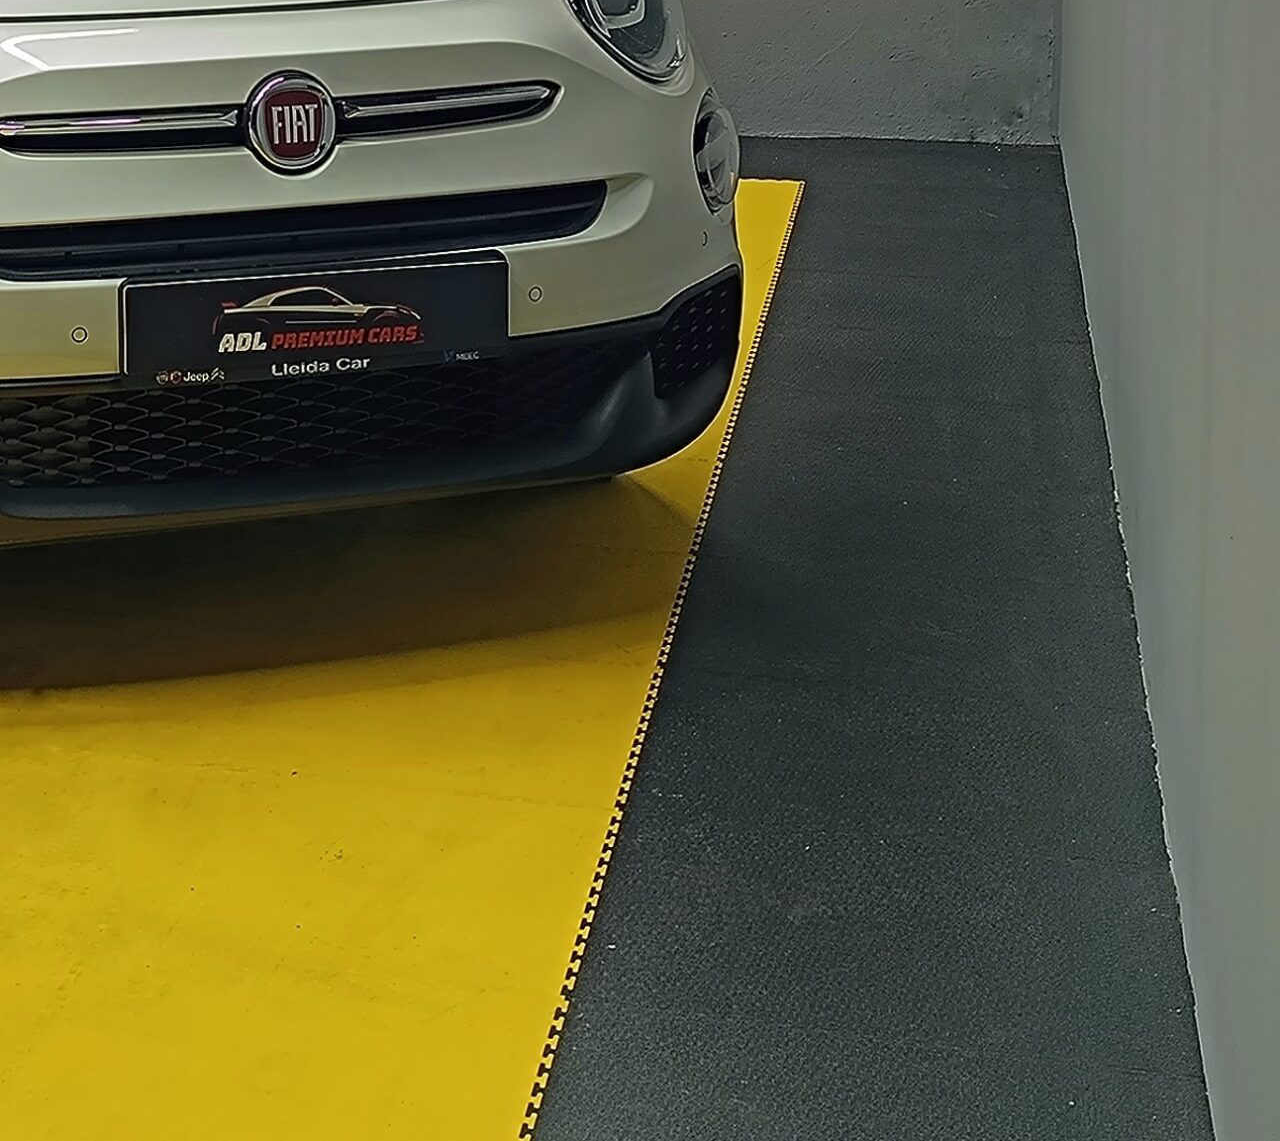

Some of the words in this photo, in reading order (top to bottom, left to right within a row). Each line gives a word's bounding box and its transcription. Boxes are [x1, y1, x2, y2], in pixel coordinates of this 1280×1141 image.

[271, 103, 318, 145] FIAT
[218, 331, 268, 353] ADL
[271, 328, 365, 350] PREMIUM
[367, 325, 418, 344] CARS
[183, 371, 210, 383] Jeep
[271, 360, 330, 377] Lleida
[336, 357, 371, 371] Car
